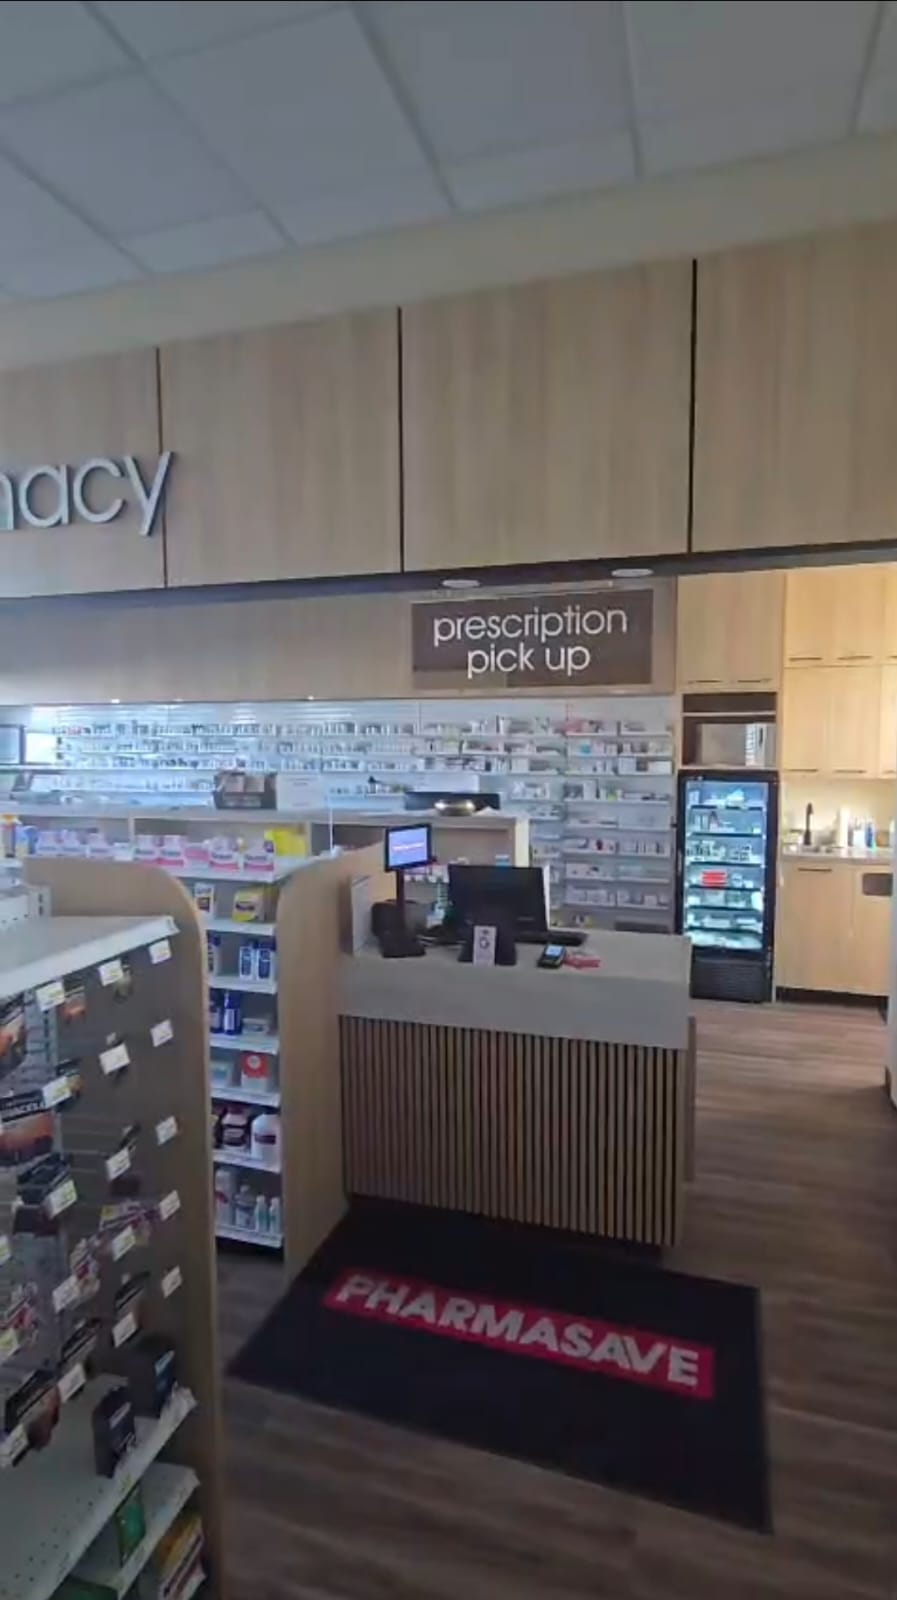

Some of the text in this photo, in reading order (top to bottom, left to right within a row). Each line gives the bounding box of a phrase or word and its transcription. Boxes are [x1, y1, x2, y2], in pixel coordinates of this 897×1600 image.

[433, 604, 628, 647] prescription
[467, 642, 591, 680] pick up
[335, 1274, 699, 1386] PHARMASAVE
